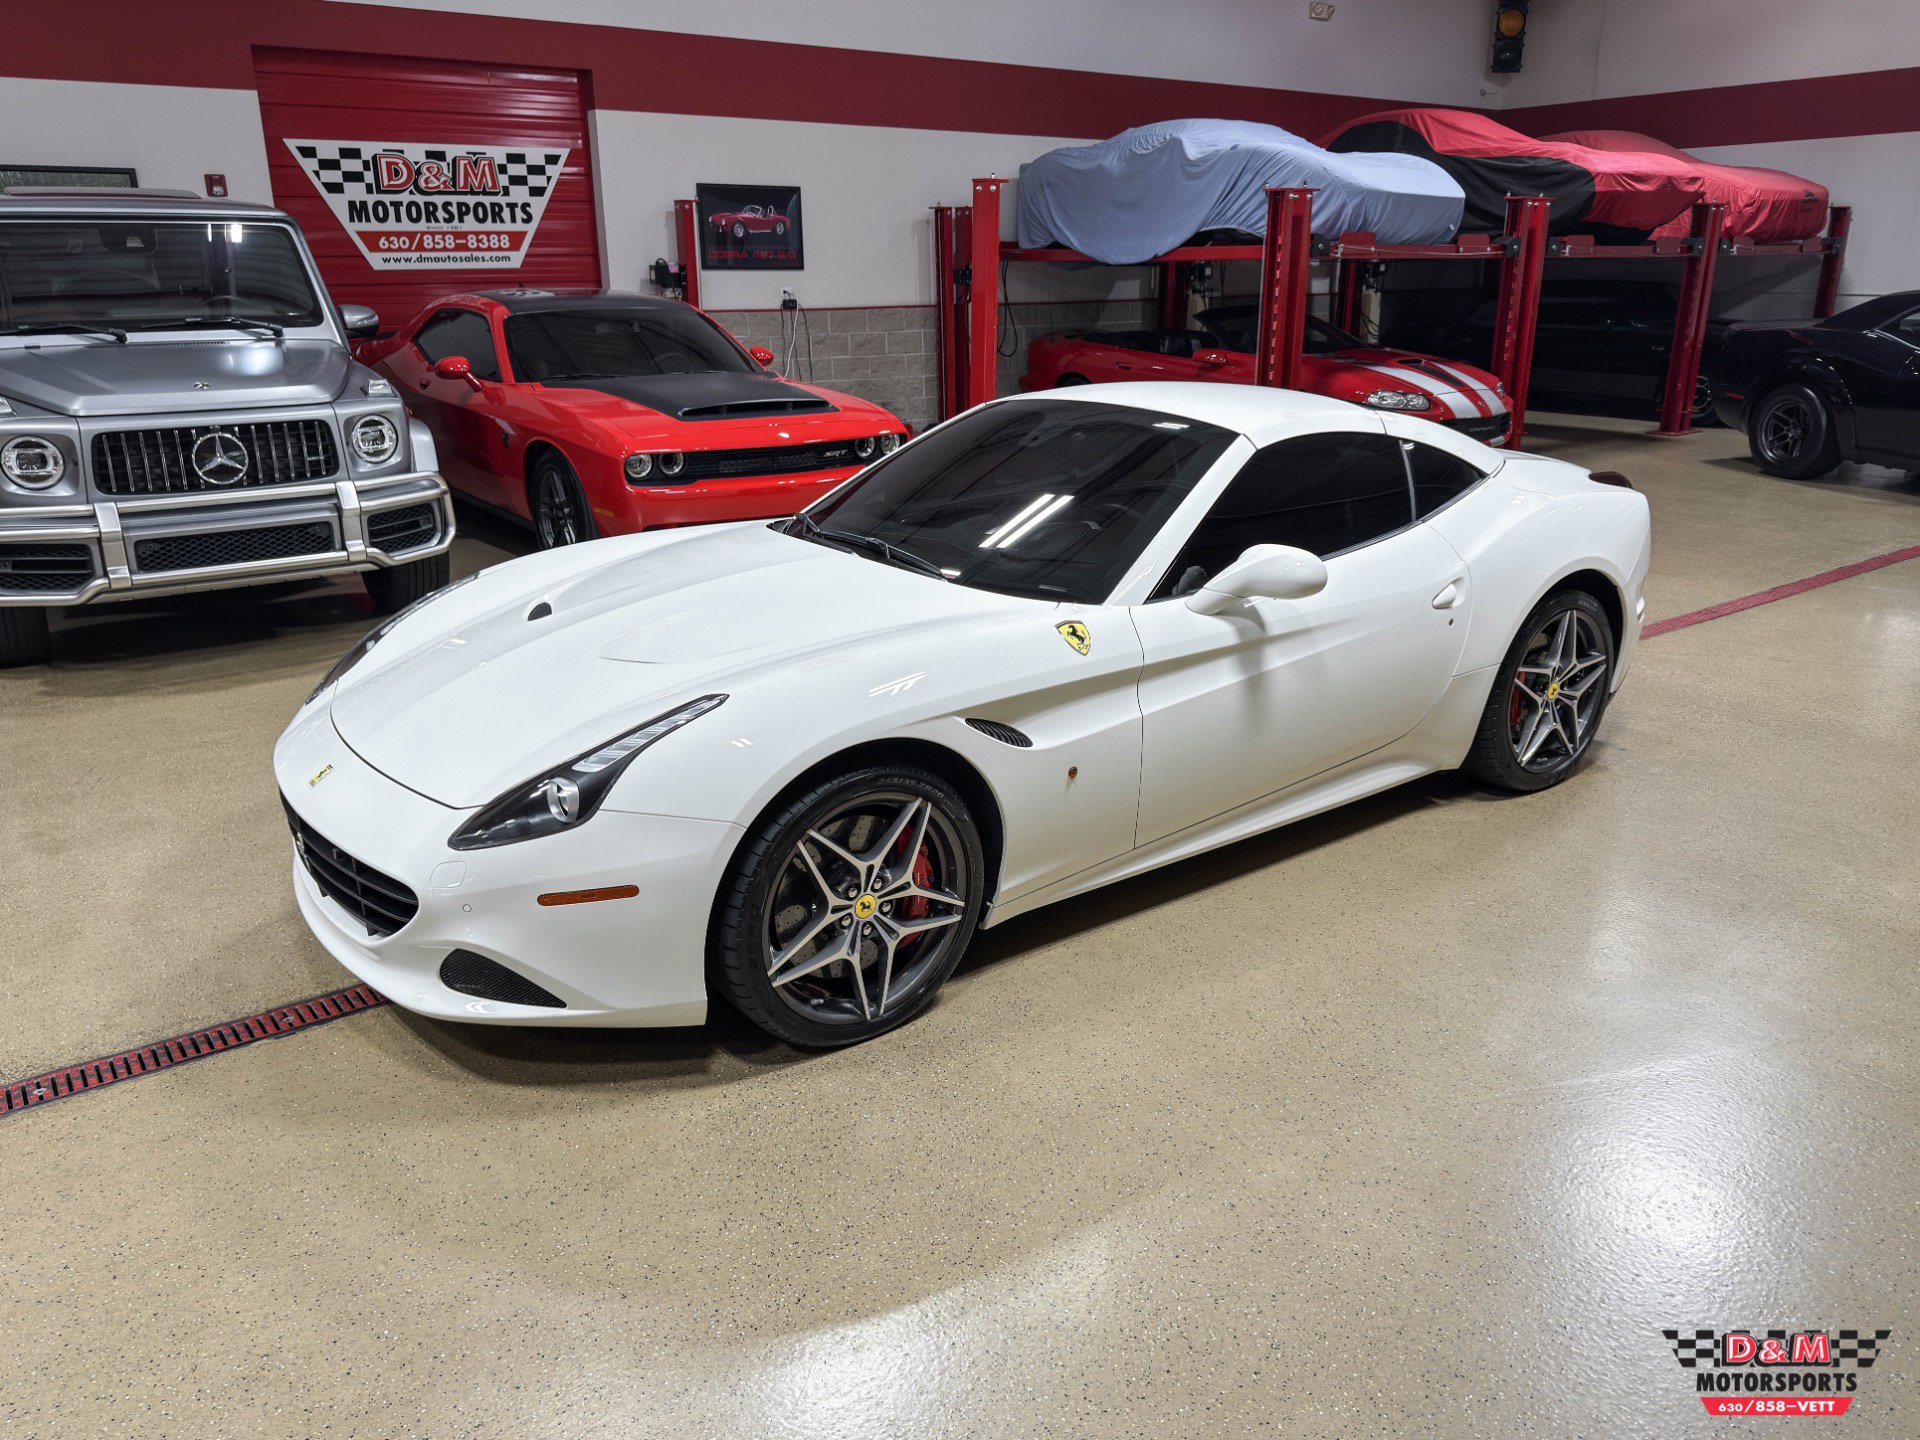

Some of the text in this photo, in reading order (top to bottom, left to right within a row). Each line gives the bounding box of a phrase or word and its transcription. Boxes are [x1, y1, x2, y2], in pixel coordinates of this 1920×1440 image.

[373, 153, 500, 195] D&M
[349, 200, 533, 224] MOTORSPORTS
[378, 233, 511, 250] 630/858-8388
[381, 253, 511, 264] www.dmautosales.com
